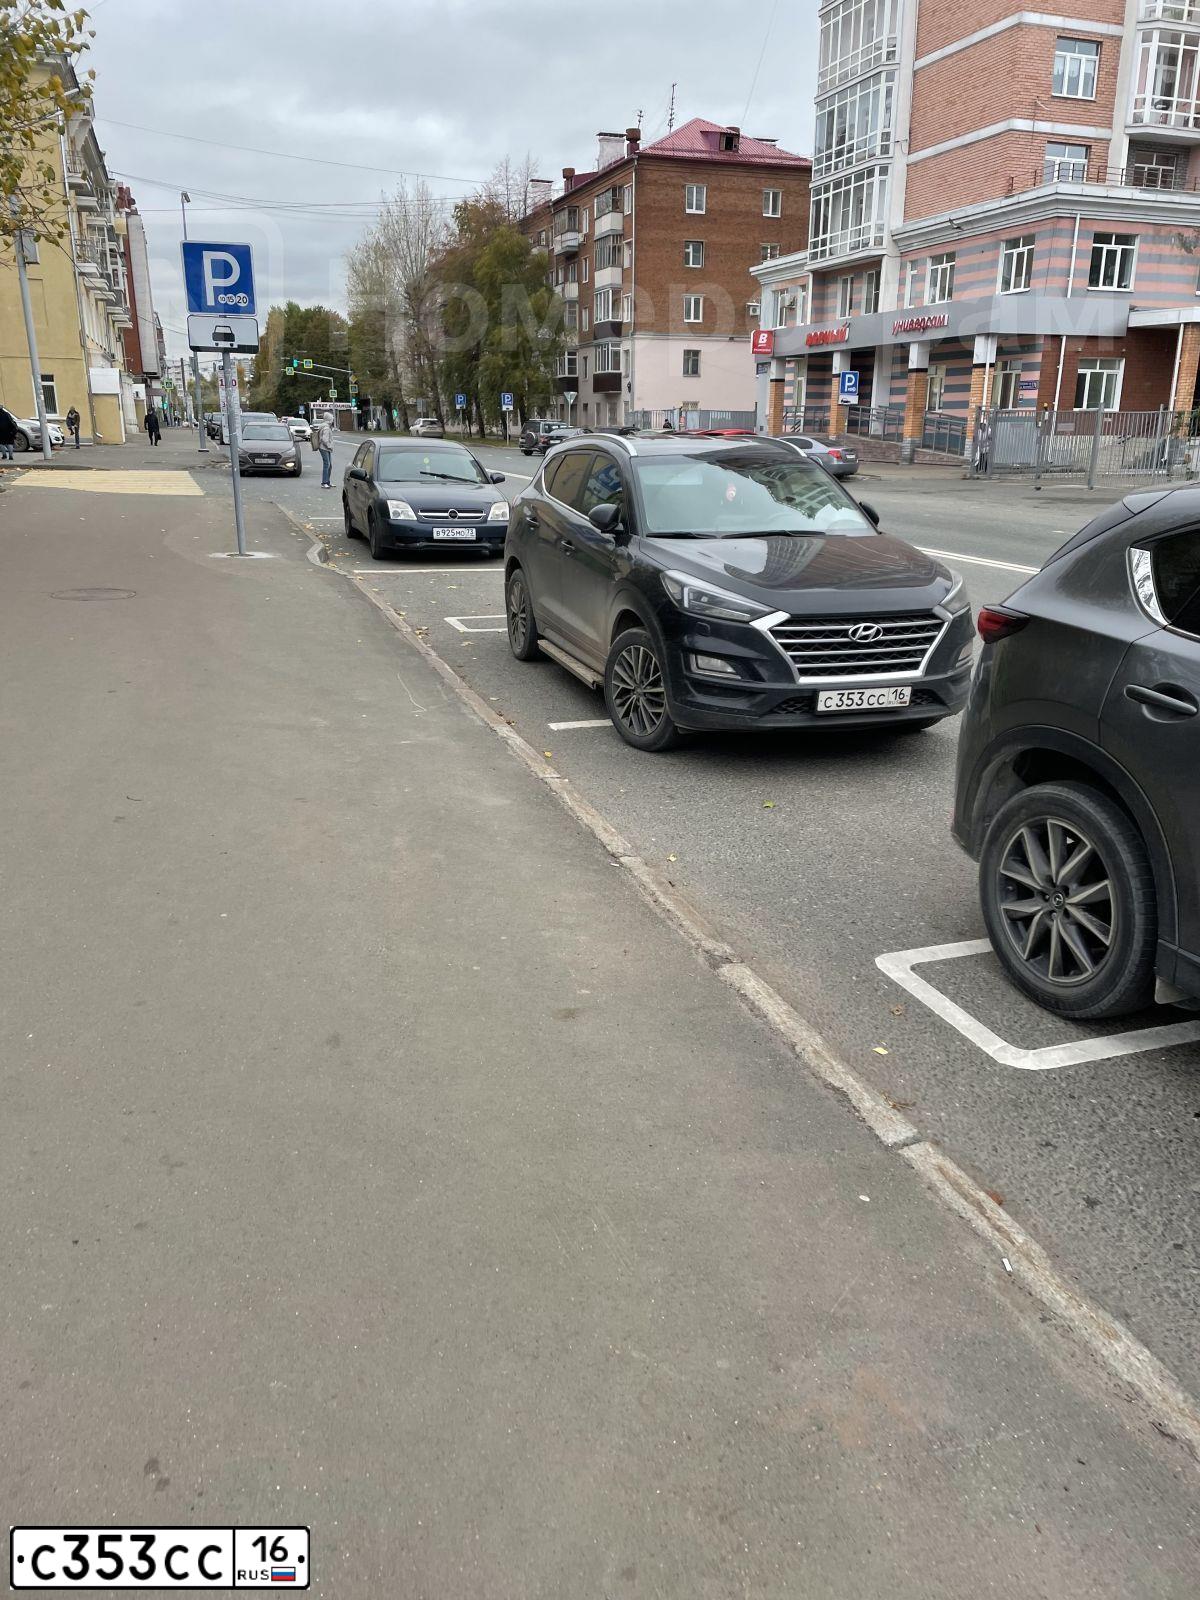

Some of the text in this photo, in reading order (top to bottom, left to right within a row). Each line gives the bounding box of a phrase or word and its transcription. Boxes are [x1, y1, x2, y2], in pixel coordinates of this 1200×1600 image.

[203, 250, 241, 306] P
[237, 295, 248, 304] 20
[844, 374, 856, 392] P
[891, 688, 906, 701] 16
